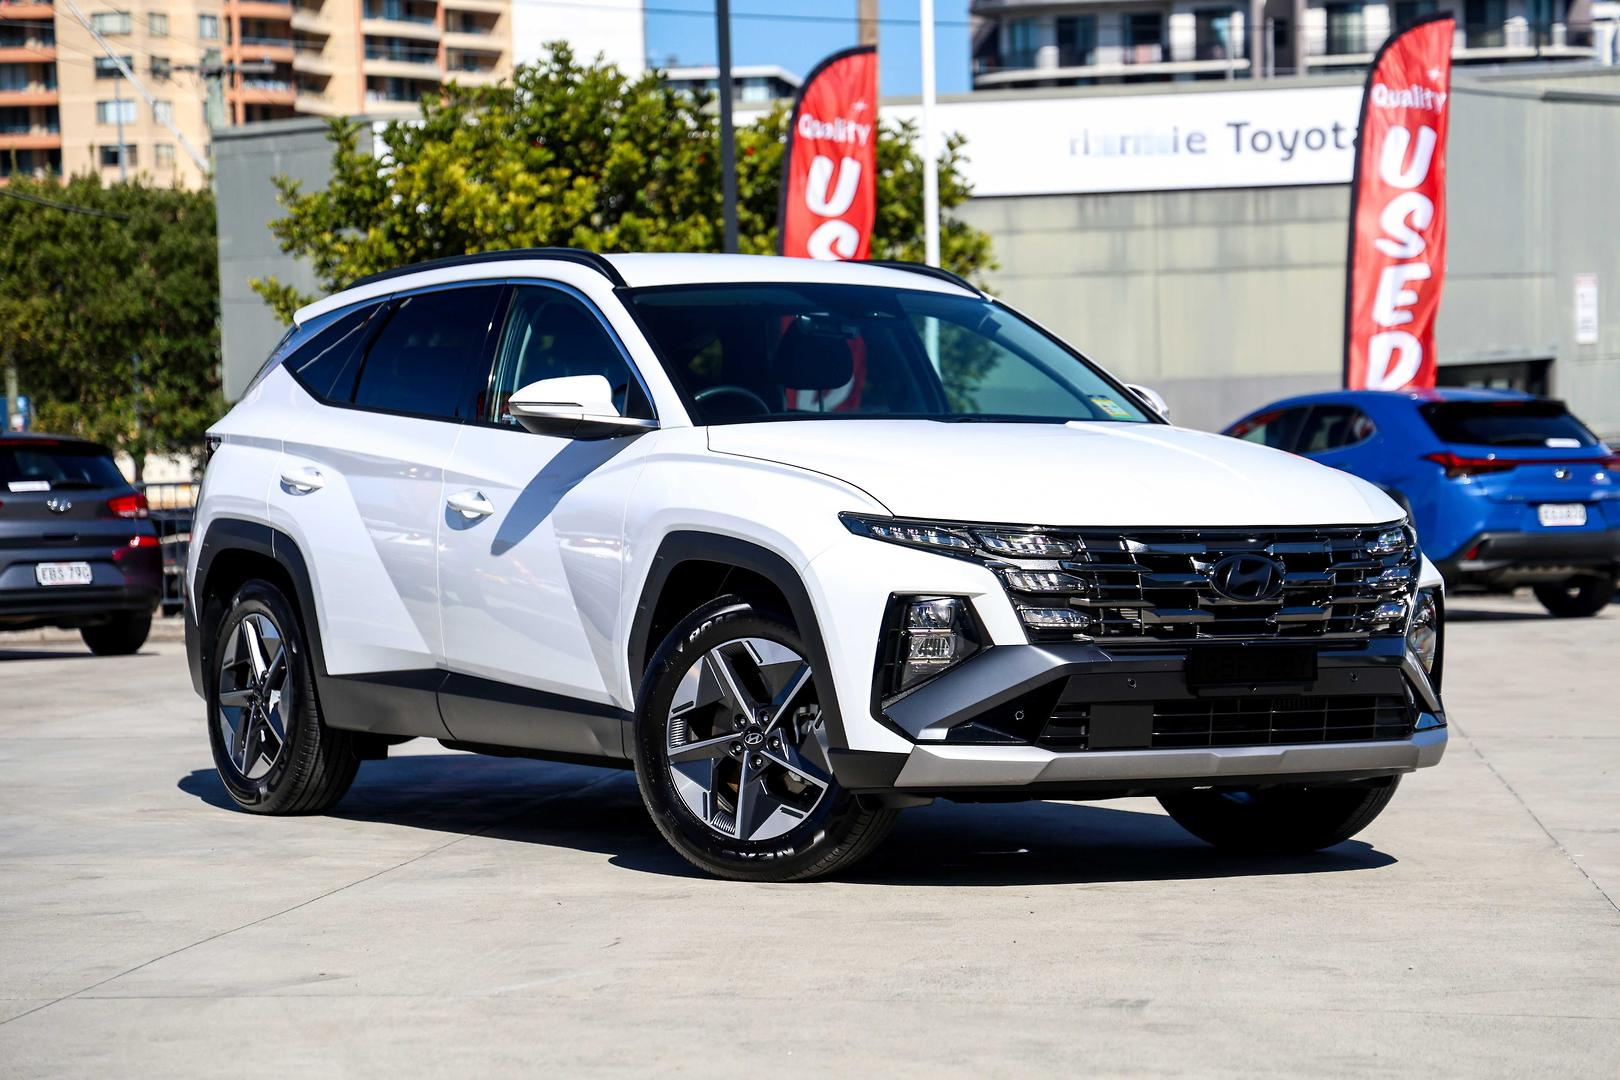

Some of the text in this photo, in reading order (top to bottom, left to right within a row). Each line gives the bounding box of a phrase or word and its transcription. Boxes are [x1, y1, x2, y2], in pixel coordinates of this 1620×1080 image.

[1371, 83, 1447, 114] Quality
[798, 113, 871, 145] Quality
[1226, 121, 1357, 161] Toyot
[1366, 125, 1438, 391] USED
